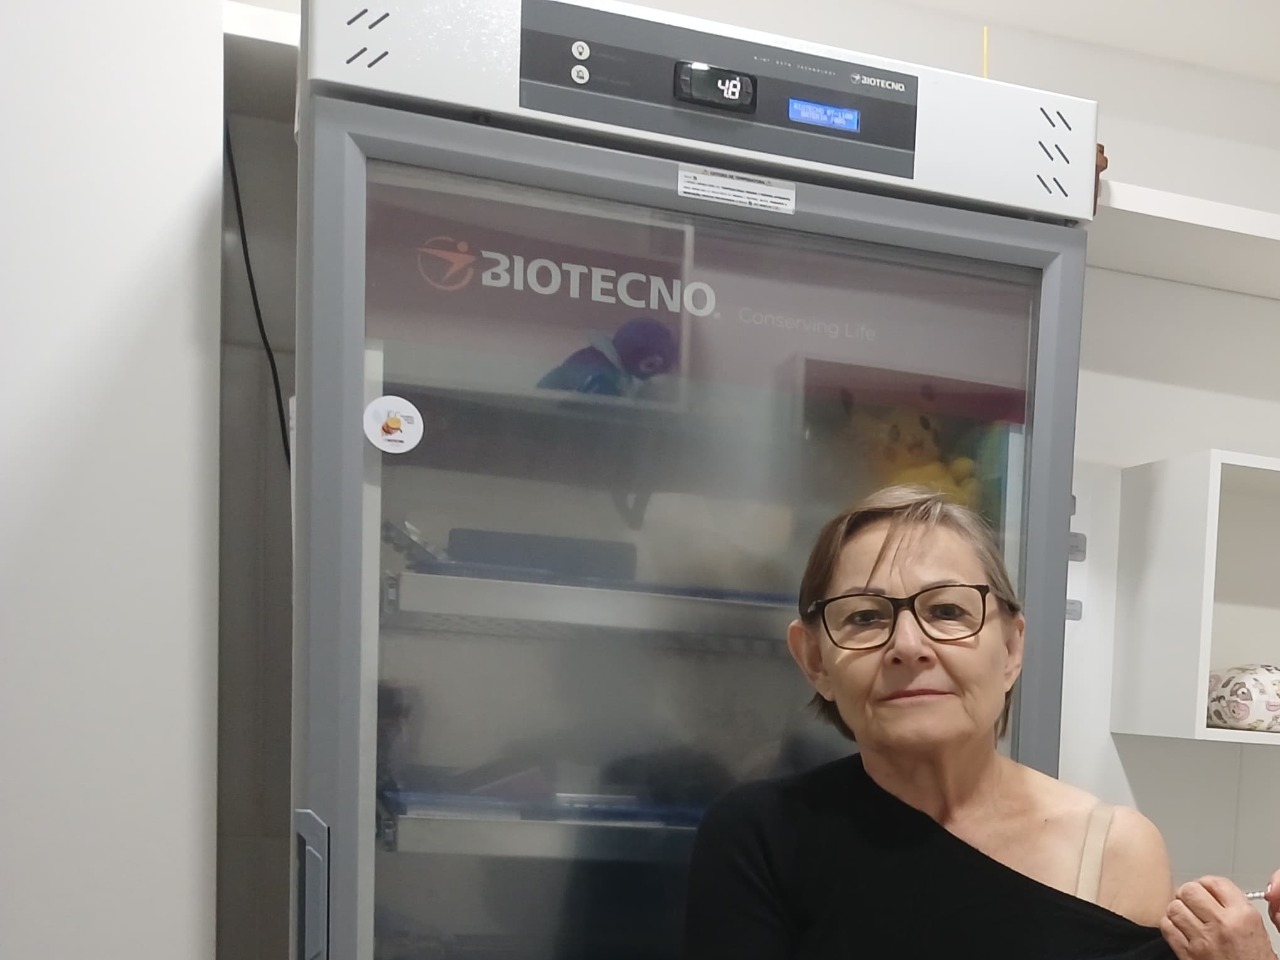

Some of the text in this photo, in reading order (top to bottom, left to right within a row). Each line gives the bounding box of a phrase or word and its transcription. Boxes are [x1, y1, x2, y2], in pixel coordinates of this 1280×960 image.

[861, 75, 905, 92] BIOTECNO
[481, 249, 877, 343] BIOTECNO Conserving Life
